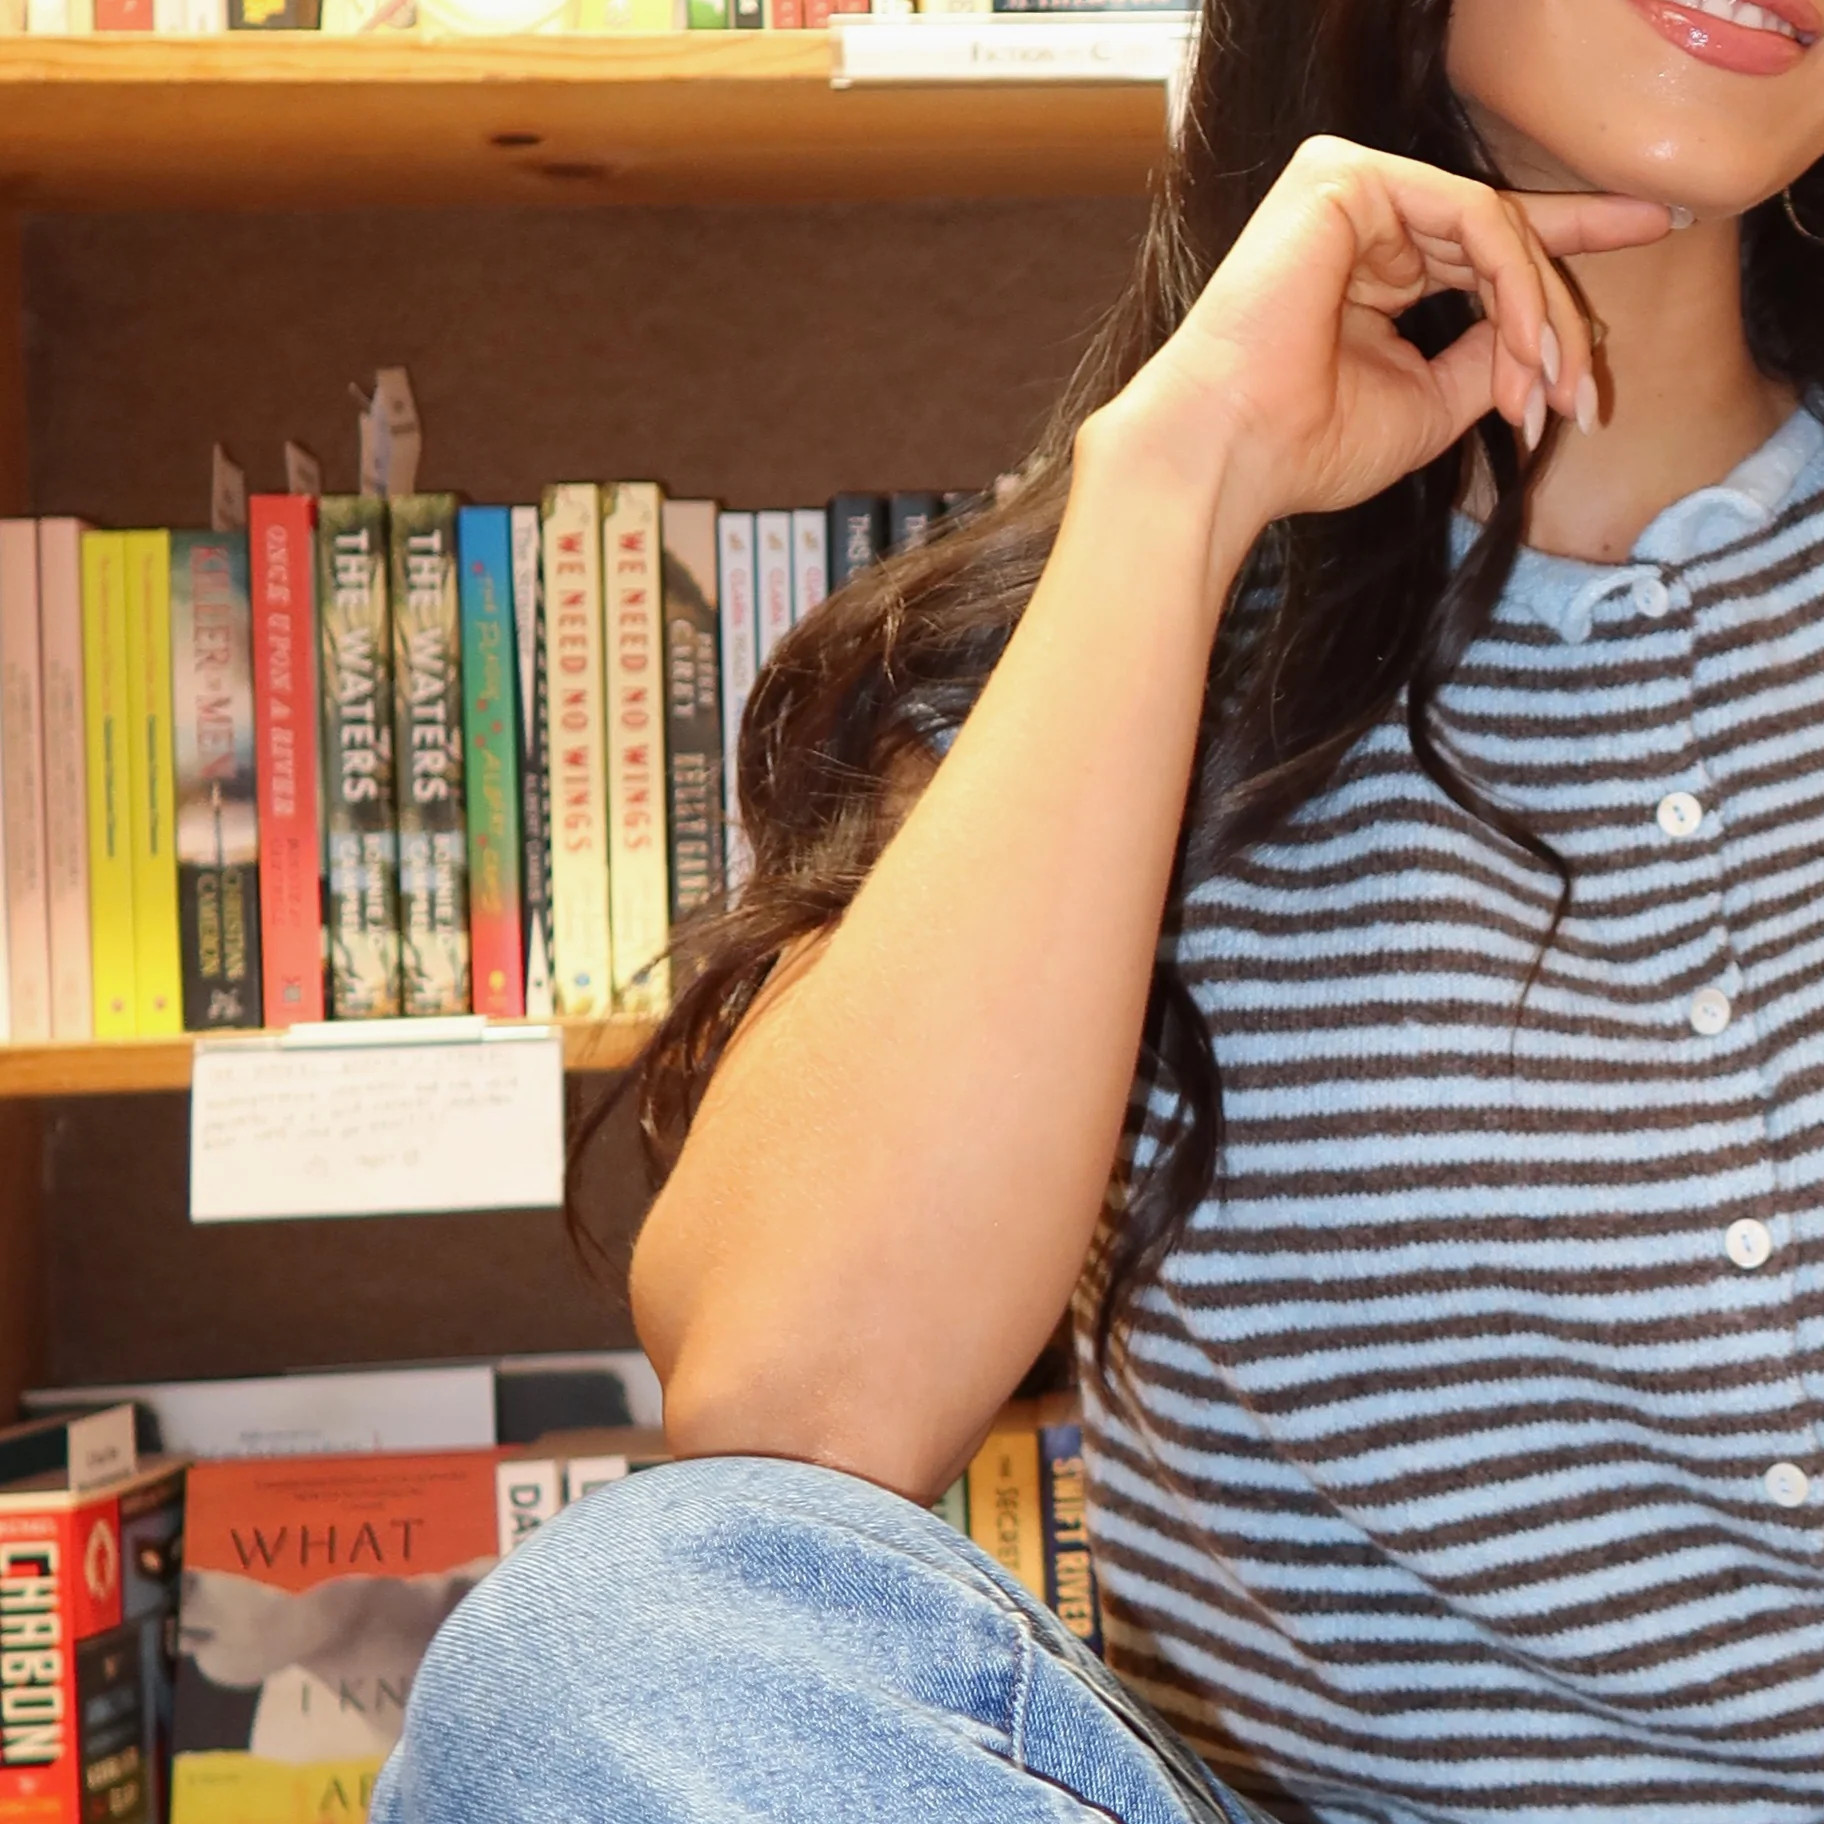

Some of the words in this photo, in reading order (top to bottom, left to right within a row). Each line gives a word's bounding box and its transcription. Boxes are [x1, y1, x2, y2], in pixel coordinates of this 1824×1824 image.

[267, 526, 289, 601] ONCE
[335, 530, 370, 607] THE
[408, 530, 443, 607] THE
[558, 531, 589, 577] WE
[618, 531, 647, 577] WE
[847, 515, 872, 561] THIS
[268, 613, 291, 692] UPON
[560, 589, 590, 673] NEED
[620, 589, 650, 673] NEED
[270, 699, 293, 719] A
[339, 627, 375, 802] WATERS
[412, 627, 448, 802] WATERS
[561, 687, 592, 733] NO
[621, 687, 651, 732] NO
[563, 743, 594, 853] WINGS
[624, 743, 654, 852] WINGS
[231, 1519, 423, 1567] WHAT
[0, 1542, 63, 1767] CHABON
